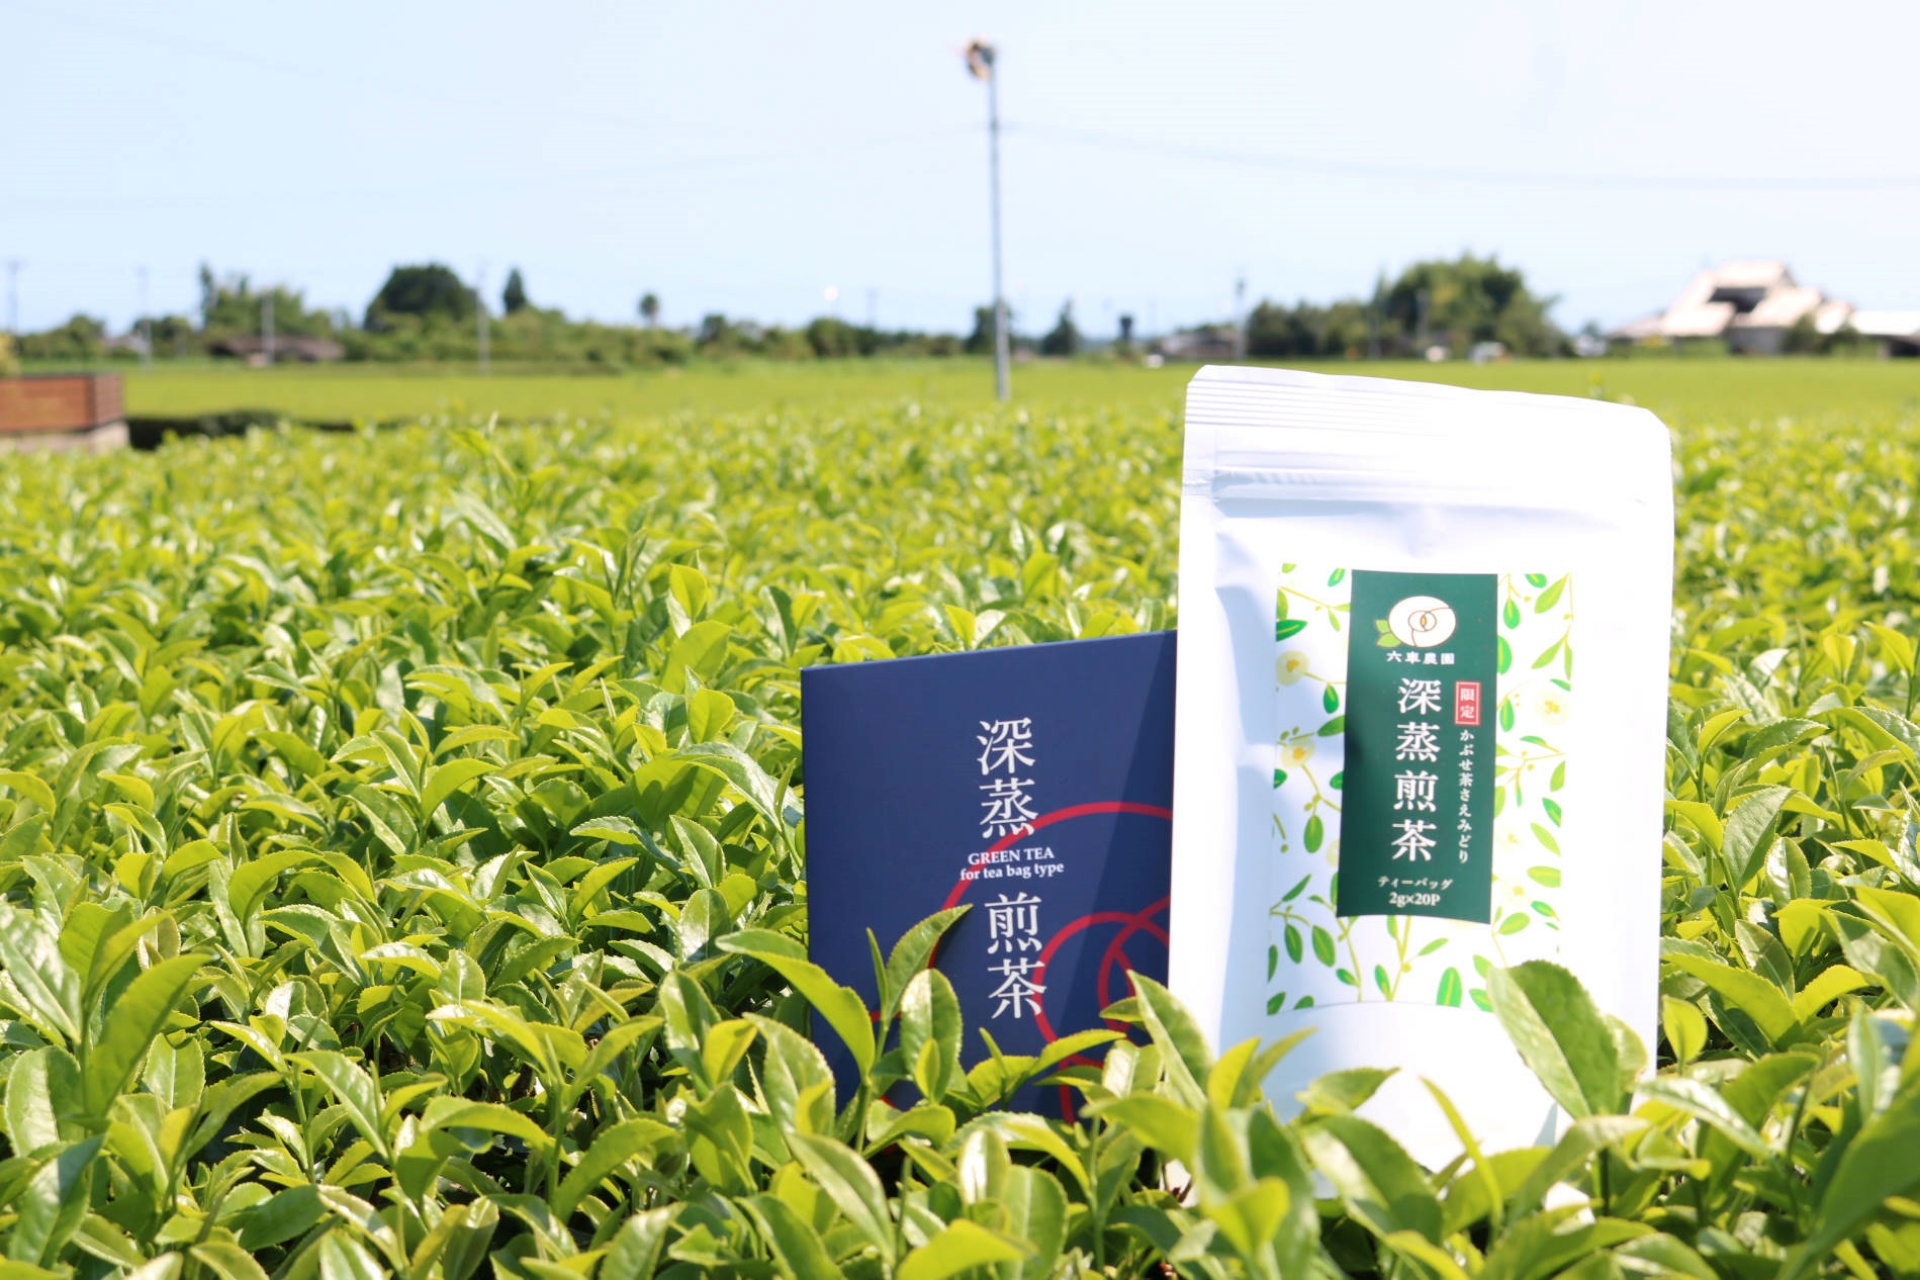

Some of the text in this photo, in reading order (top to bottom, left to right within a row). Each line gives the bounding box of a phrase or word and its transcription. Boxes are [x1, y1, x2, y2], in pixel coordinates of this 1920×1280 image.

[1386, 650, 1455, 665] 六車農園
[1460, 686, 1476, 719] 限定
[1391, 677, 1443, 862] 深蒸煎茶
[1457, 729, 1475, 864] かぶせ茶さえみどり
[967, 846, 1055, 866] GREEN TEA
[960, 862, 1065, 881] for tea bag type
